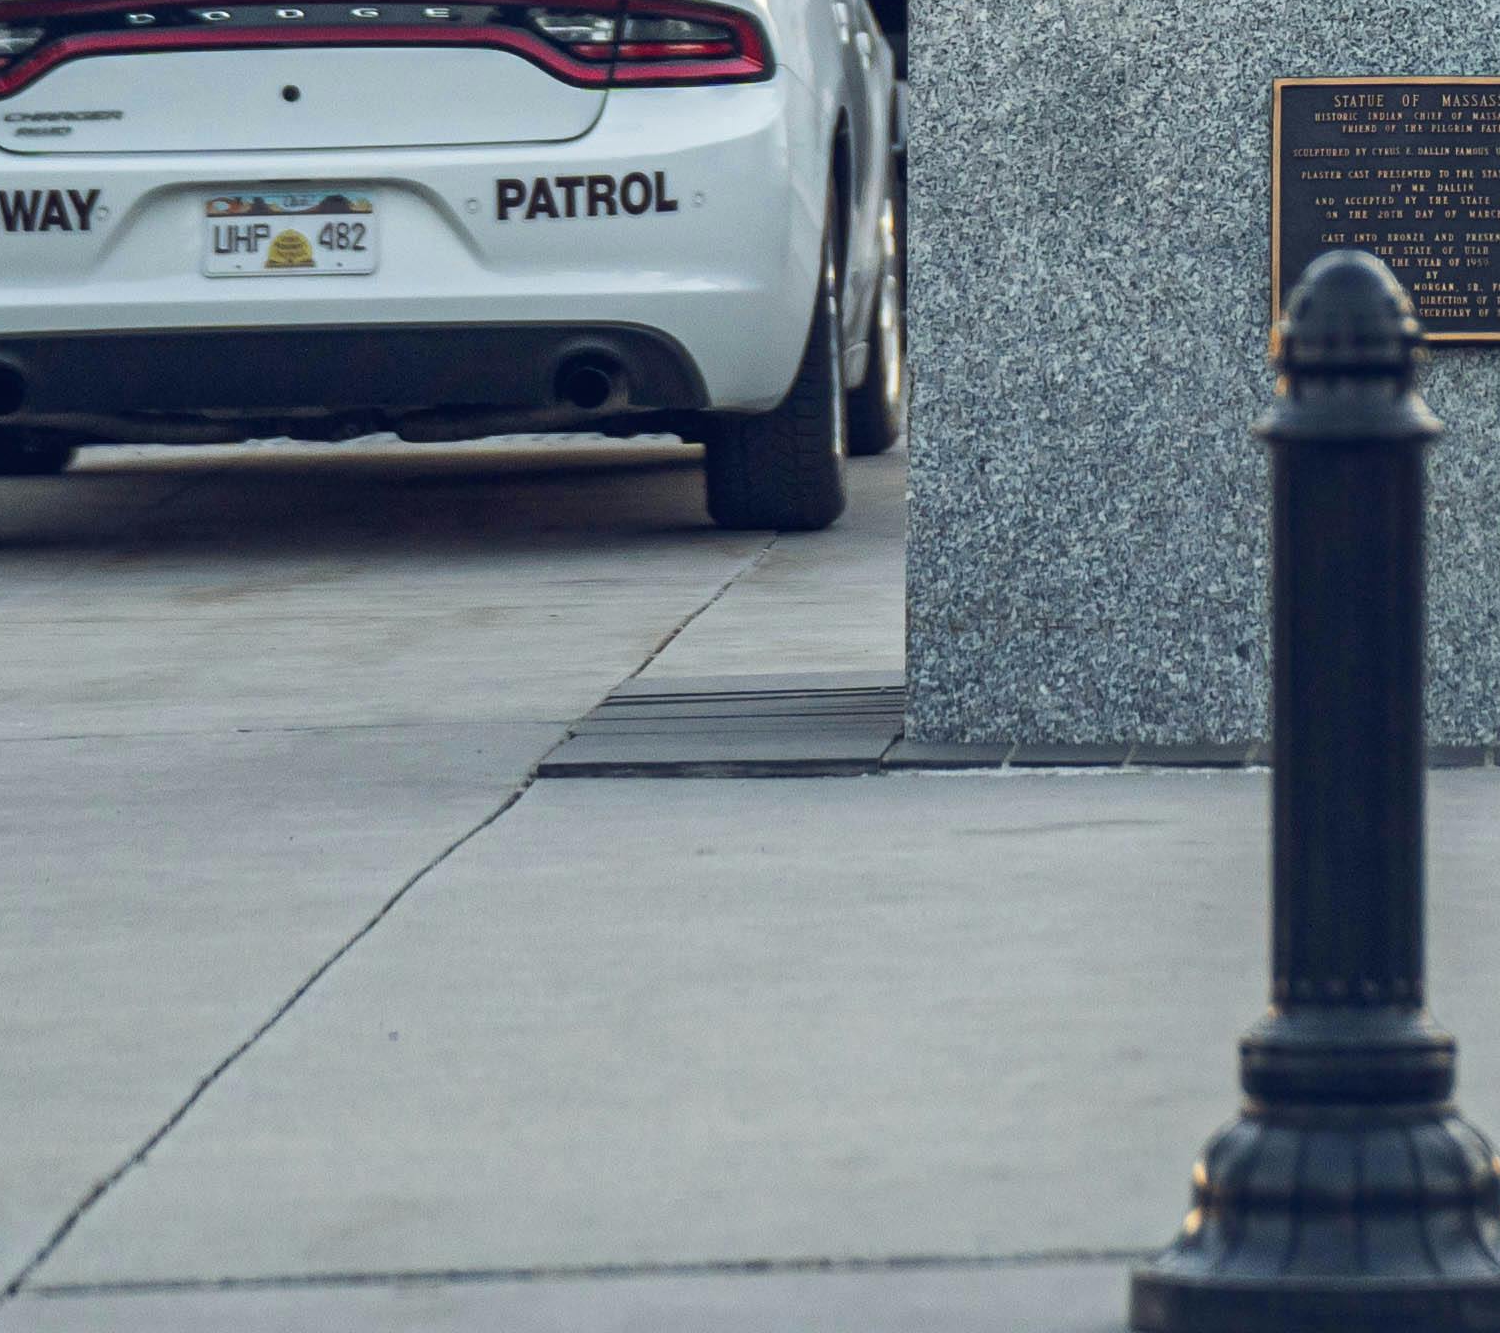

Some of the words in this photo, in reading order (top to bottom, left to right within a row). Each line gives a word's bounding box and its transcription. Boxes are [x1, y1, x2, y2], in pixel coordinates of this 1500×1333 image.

[127, 6, 451, 24] DODGE
[1334, 94, 1385, 108] STATUE
[1402, 94, 1420, 108] OF
[1315, 111, 1358, 122] HISTORIC
[1368, 111, 1403, 122] INDIAN
[1414, 111, 1442, 122] CHIEF
[1451, 111, 1462, 122] OF
[1342, 124, 1377, 133] FRIEND
[1385, 124, 1397, 133] OF
[1405, 124, 1423, 133] THE
[1431, 124, 1473, 133] PILGRIM
[1293, 148, 1350, 157] SCULPTURED
[1355, 148, 1367, 157] BY
[1372, 148, 1400, 157] CYRUS
[1417, 148, 1450, 157] DALLIN
[1455, 148, 1489, 157] FAMOUS
[1301, 170, 1342, 179] PLASTER
[1348, 170, 1370, 179] CAST
[1377, 170, 1432, 179] PRESENTED
[1439, 170, 1449, 179] TO
[1456, 170, 1474, 179] THE
[1391, 184, 1403, 192] BY
[1437, 184, 1476, 192] DALLIN
[496, 171, 679, 221] PATROL
[1315, 196, 1335, 206] AND
[1345, 196, 1395, 206] ACCEPTED
[1404, 196, 1417, 206] BY
[1429, 196, 1449, 206] THE
[1460, 196, 1491, 206] STATE
[1349, 210, 1368, 219] THE
[1415, 210, 1434, 219] DAY
[1445, 210, 1457, 219] OF
[214, 223, 270, 254] UHP
[318, 222, 367, 251] 482
[1322, 233, 1345, 243] CAST
[1354, 233, 1378, 243] INTO
[1387, 233, 1425, 243] BRONZE
[1434, 233, 1454, 243] AND
[1374, 246, 1394, 255] THE
[1403, 246, 1432, 255] STATE
[1442, 246, 1454, 255] OF
[1464, 246, 1489, 255] UTAH
[1391, 258, 1410, 267] THE
[1417, 258, 1442, 267] YEAR
[1449, 258, 1461, 267] OF
[1426, 271, 1439, 280] BY
[1420, 296, 1468, 305] DIRECTION
[1476, 296, 1489, 305] OF
[1419, 308, 1471, 318] SECRETARY
[1479, 308, 1490, 318] OF
